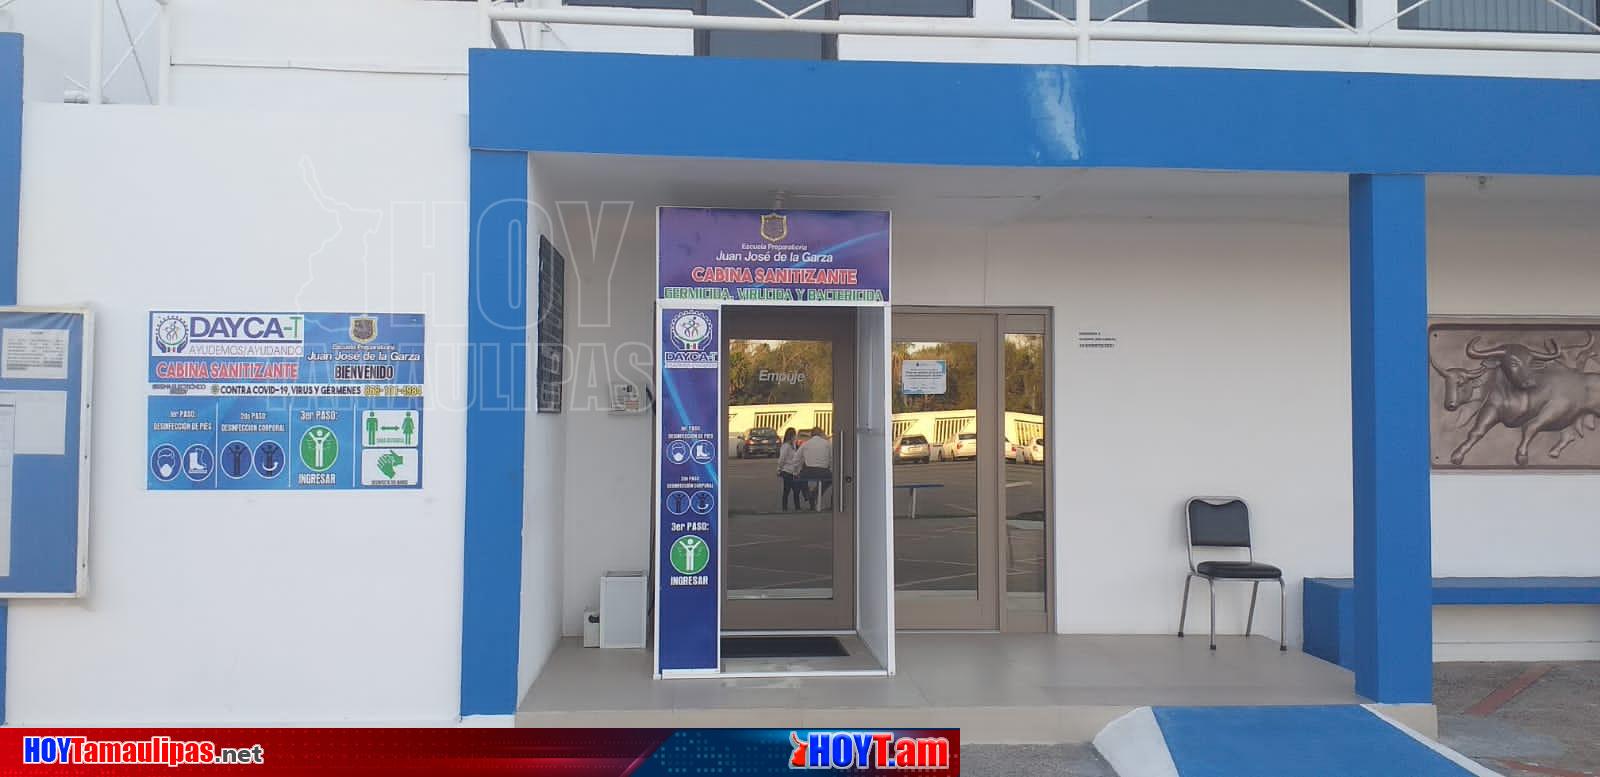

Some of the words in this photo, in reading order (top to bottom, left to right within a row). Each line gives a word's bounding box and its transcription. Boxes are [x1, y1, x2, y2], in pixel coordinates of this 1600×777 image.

[716, 251, 742, 262] Juan
[745, 251, 771, 262] José
[774, 252, 788, 262] de
[790, 252, 800, 262] la
[802, 252, 833, 263] Garza
[691, 267, 752, 284] CABINA
[754, 267, 858, 285] SANITIZANTE
[737, 287, 795, 301] VIRUCIDA
[796, 288, 807, 301] Y
[807, 288, 883, 302] BACTERICIDA
[190, 316, 302, 338] DAYCA-T
[307, 351, 332, 361] Juan
[335, 351, 360, 361] José
[363, 351, 376, 360] de
[379, 351, 387, 361] la
[390, 351, 420, 361] Garza
[156, 362, 209, 379] CABINA
[210, 362, 298, 380] SANITIZANTE
[335, 364, 394, 379] BIENVENIDO
[759, 369, 806, 385] Empuje
[220, 385, 251, 394] CONTRA
[291, 385, 312, 394] VIRUS
[314, 385, 320, 394] Y
[300, 411, 312, 420] 3er
[316, 411, 338, 420] PASO:
[298, 473, 336, 486] INGRESAR
[671, 522, 685, 531] 3er
[687, 522, 710, 532] PASO:
[670, 575, 708, 586] INGRESAR
